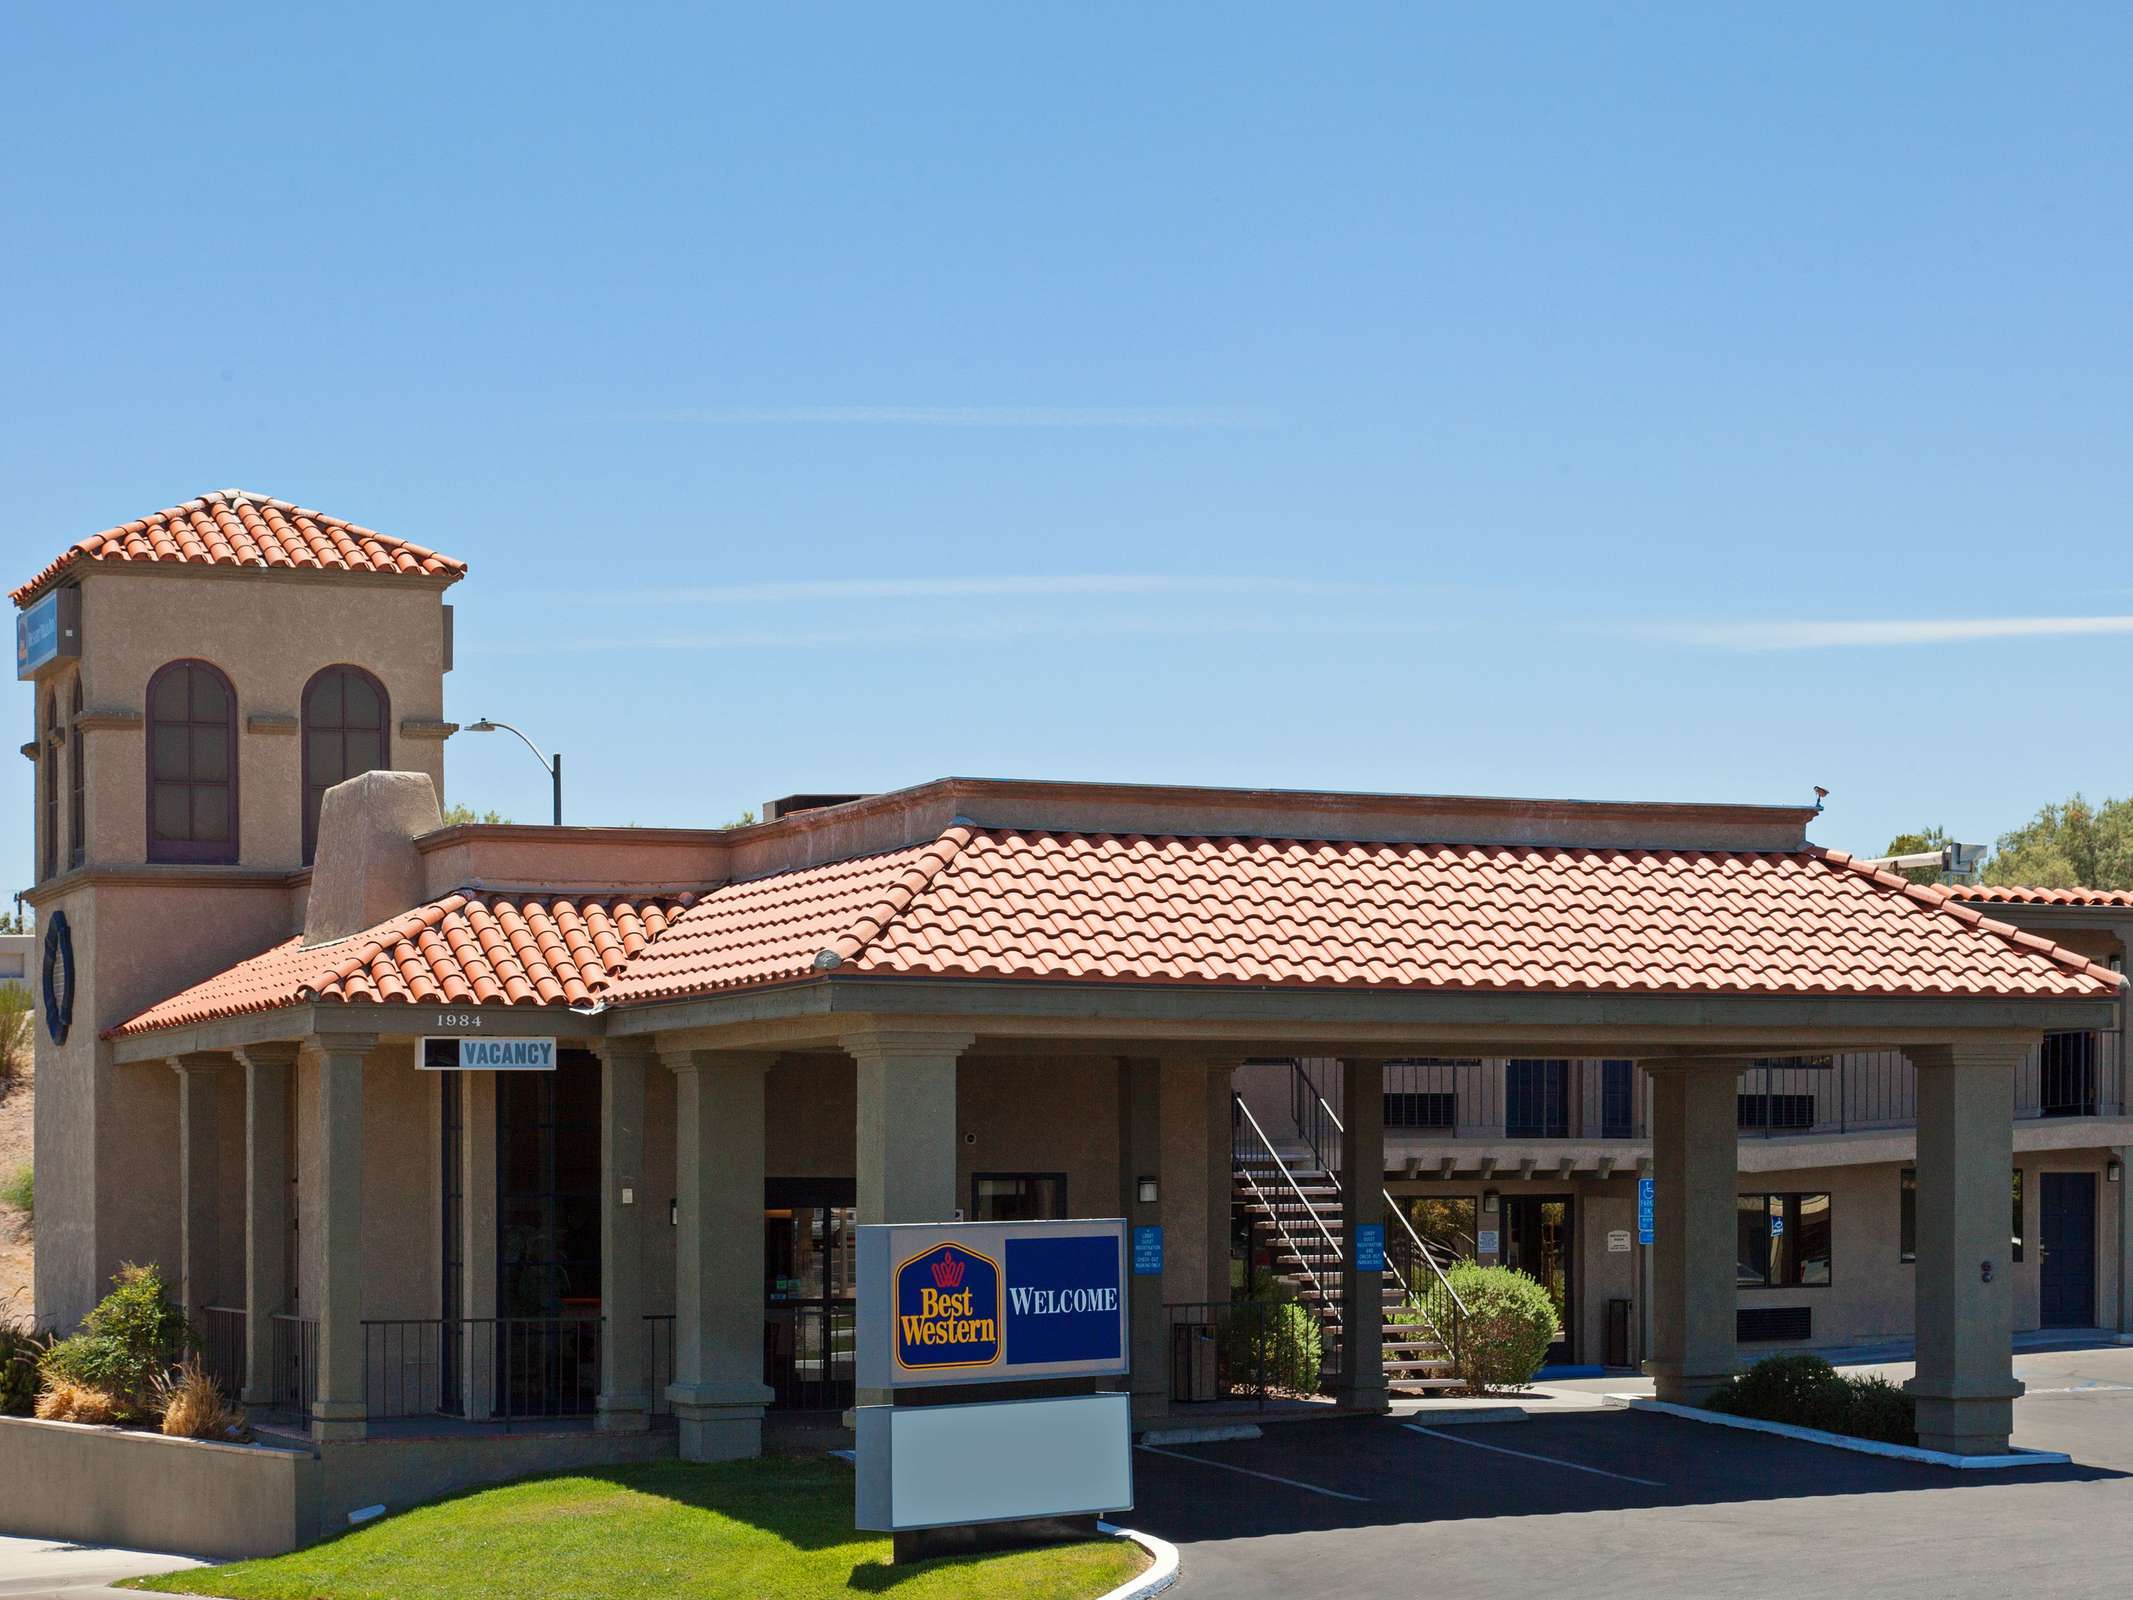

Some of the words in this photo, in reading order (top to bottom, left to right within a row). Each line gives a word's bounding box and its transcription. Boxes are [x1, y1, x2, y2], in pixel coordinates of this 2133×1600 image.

[437, 1014, 482, 1027] 1984
[464, 1043, 552, 1065] VACANCY
[921, 1286, 973, 1318] Best
[1009, 1286, 1118, 1316] WELCOME
[901, 1308, 995, 1345] Western
